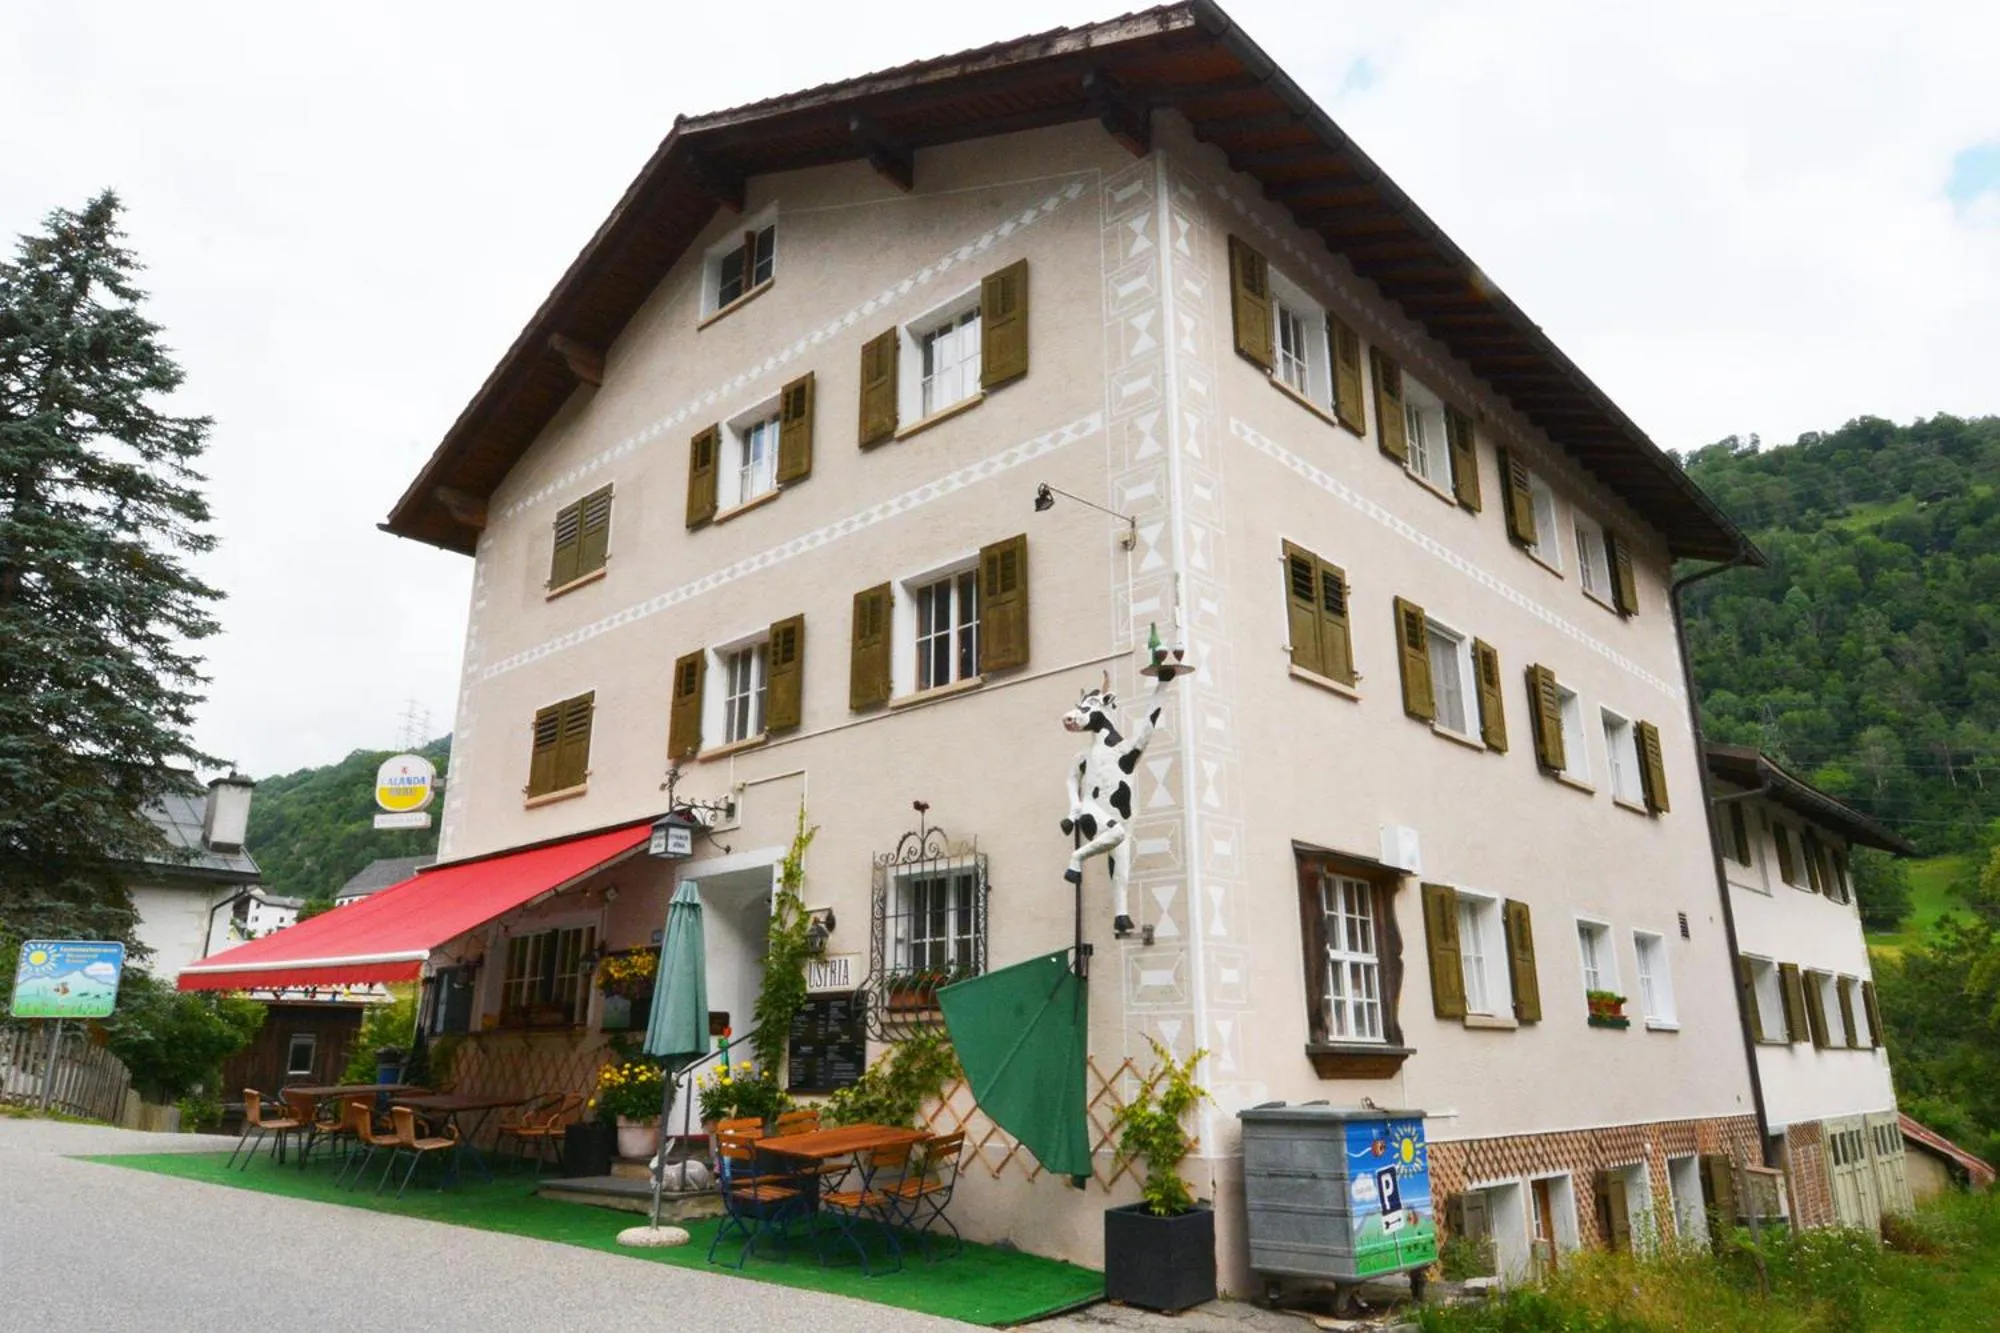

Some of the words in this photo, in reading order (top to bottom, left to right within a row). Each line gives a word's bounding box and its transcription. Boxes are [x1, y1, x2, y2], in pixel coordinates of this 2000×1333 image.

[381, 776, 426, 785] ALANDA
[808, 958, 849, 988] USTRIA
[1381, 1172, 1394, 1211] P
